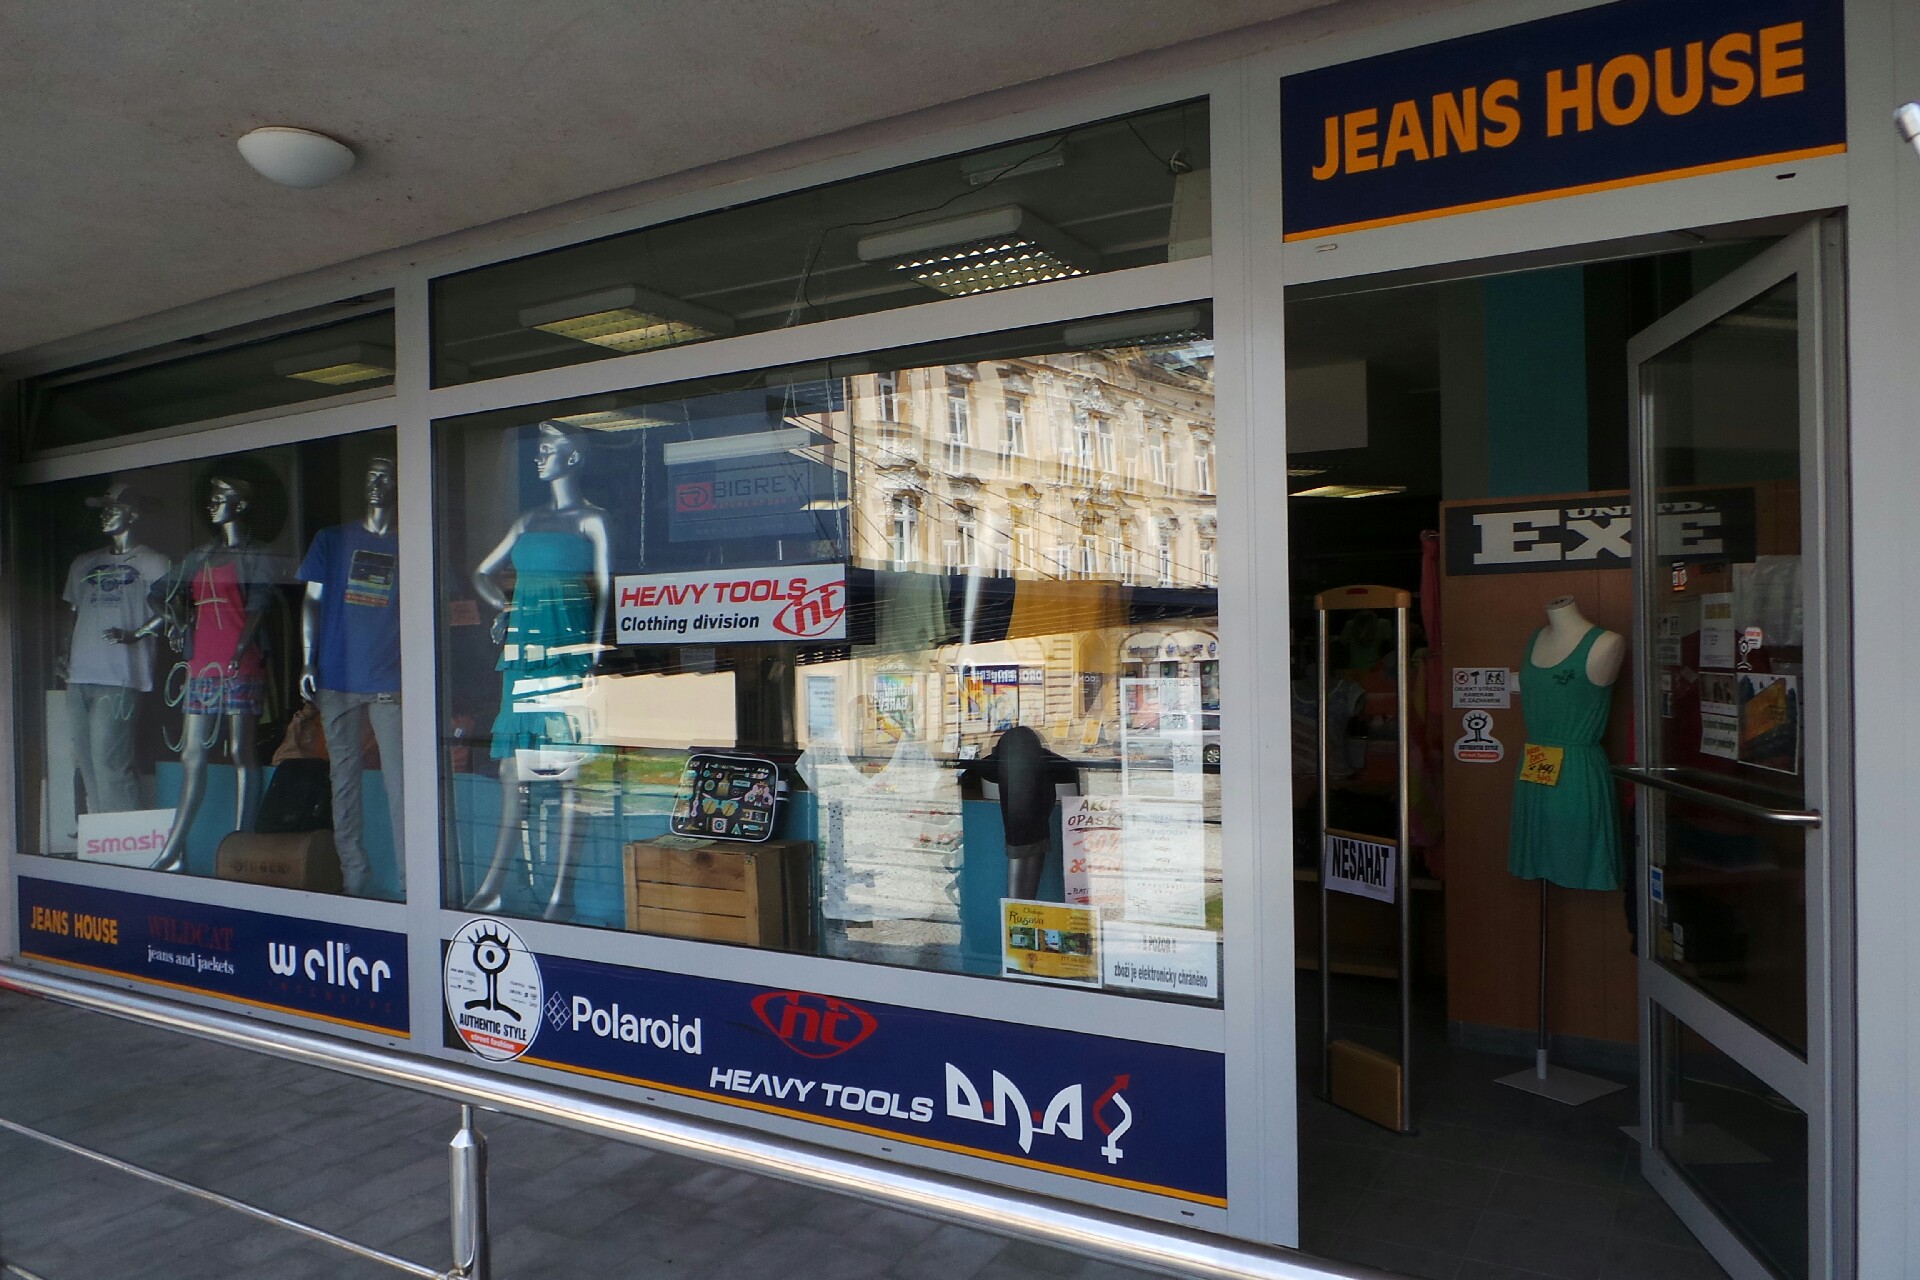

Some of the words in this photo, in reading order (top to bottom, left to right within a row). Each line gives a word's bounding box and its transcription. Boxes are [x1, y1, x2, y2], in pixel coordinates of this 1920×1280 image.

[1312, 79, 1521, 181] JEANS
[1546, 20, 1805, 138] HOUSE
[712, 474, 804, 499] BIGREY
[620, 583, 710, 608] HEAVY
[713, 577, 808, 604] TOOLS
[620, 614, 688, 635] Clothing
[692, 613, 760, 631] division
[1332, 838, 1389, 888] NESAHAT
[31, 905, 69, 936] JEANS
[74, 912, 118, 945] HOUSE
[147, 914, 235, 952] WILDCAT
[147, 944, 175, 965] jeans
[175, 951, 196, 969] and
[196, 953, 235, 976] jackets
[1138, 964, 1177, 988] elektronicky
[459, 1012, 501, 1036] AUTHENTIC
[503, 1023, 527, 1042] STYLE
[572, 995, 702, 1056] Polaroid
[709, 1066, 818, 1103] HEAVY
[821, 1083, 934, 1123] TOOLS
